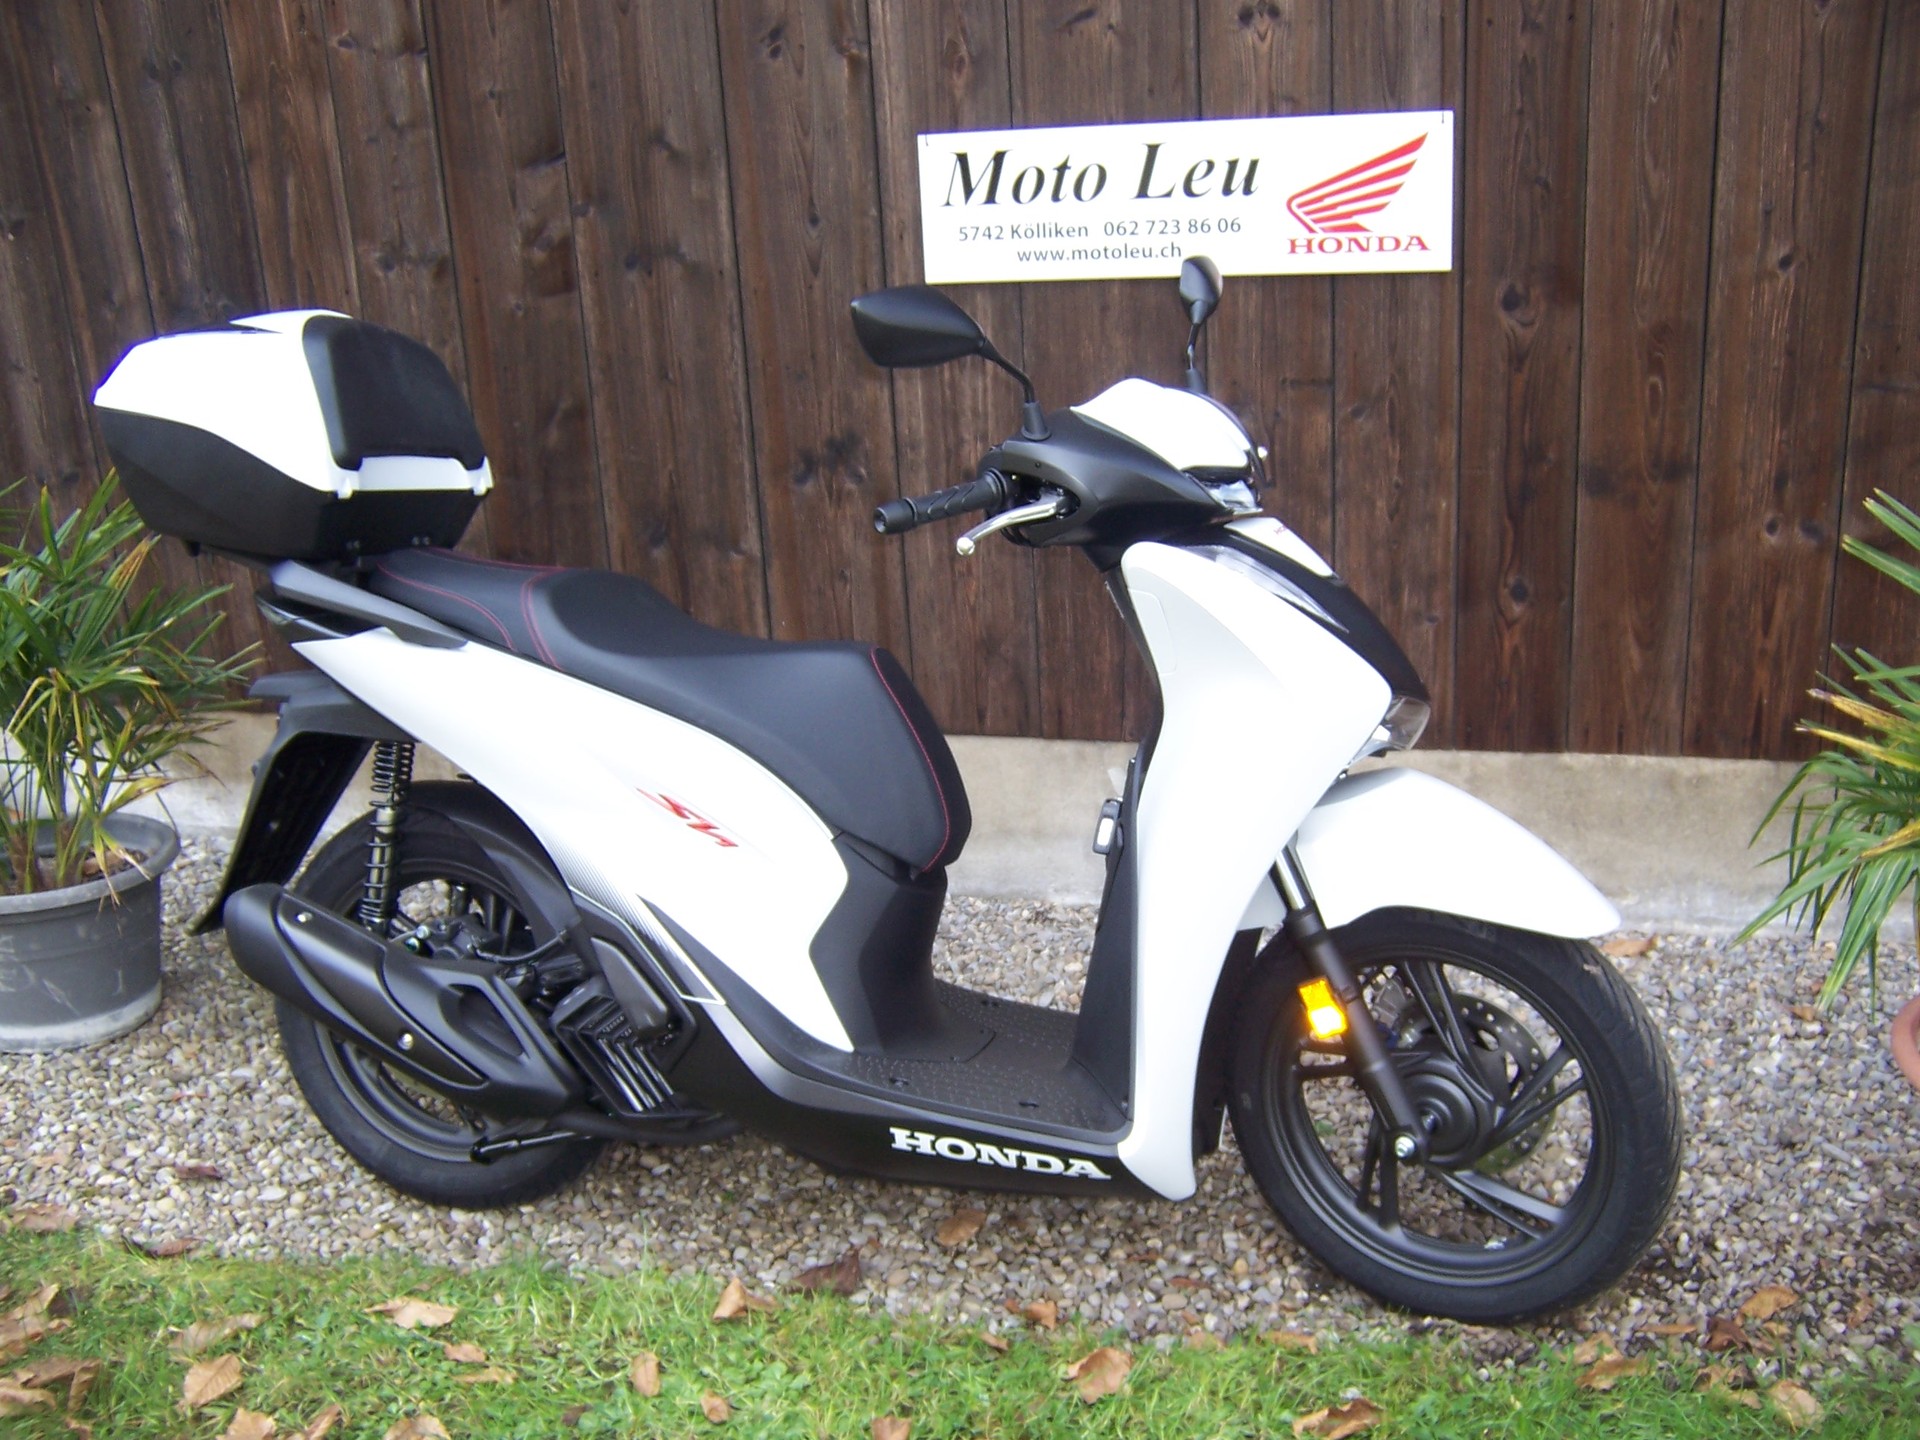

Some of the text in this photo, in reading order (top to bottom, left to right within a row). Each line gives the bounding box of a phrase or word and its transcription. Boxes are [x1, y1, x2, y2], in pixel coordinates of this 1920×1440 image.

[941, 142, 1261, 207] Moto Leu
[959, 217, 1242, 241] 5742 Kölliken 062 723 86 06
[1017, 242, 1182, 262] www.motoleu.ch
[1288, 234, 1431, 255] HONDA
[889, 1126, 1112, 1180] HONDA
